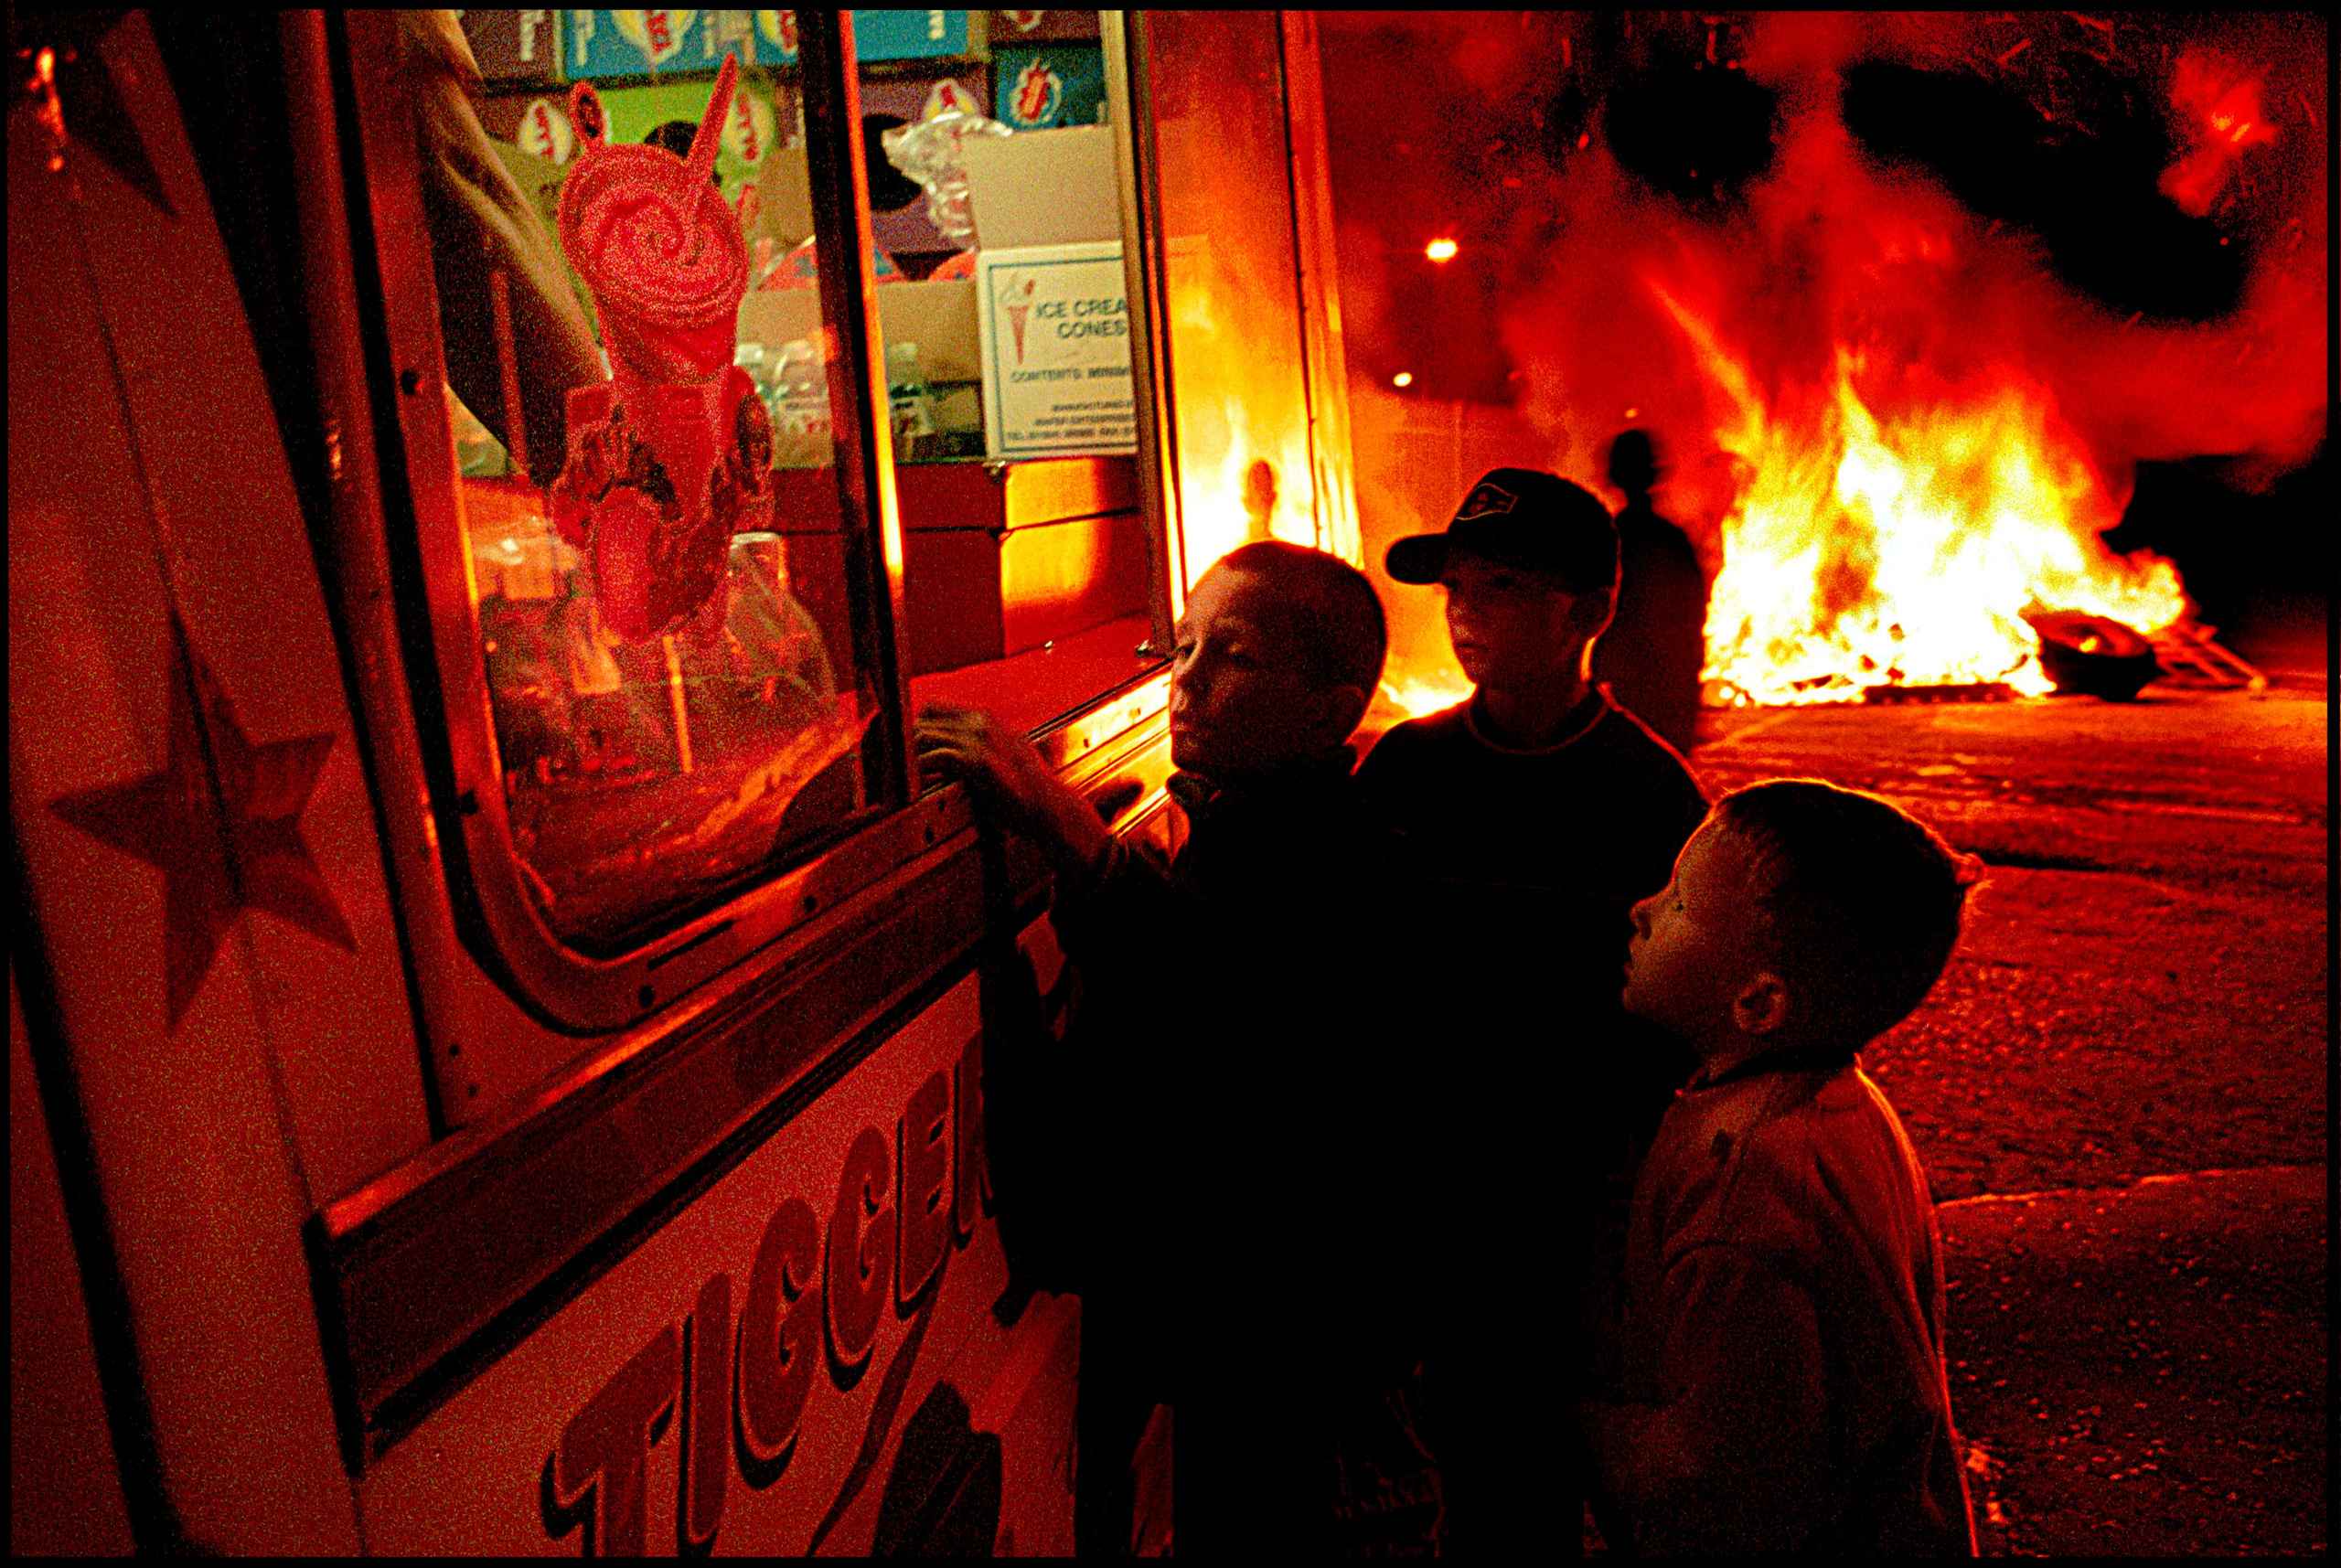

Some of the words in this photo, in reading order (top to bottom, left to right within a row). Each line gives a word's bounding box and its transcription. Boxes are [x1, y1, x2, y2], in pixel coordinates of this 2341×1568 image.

[1035, 301, 1067, 319] ICE
[1073, 299, 1128, 316] CREA
[1057, 321, 1128, 339] CONES
